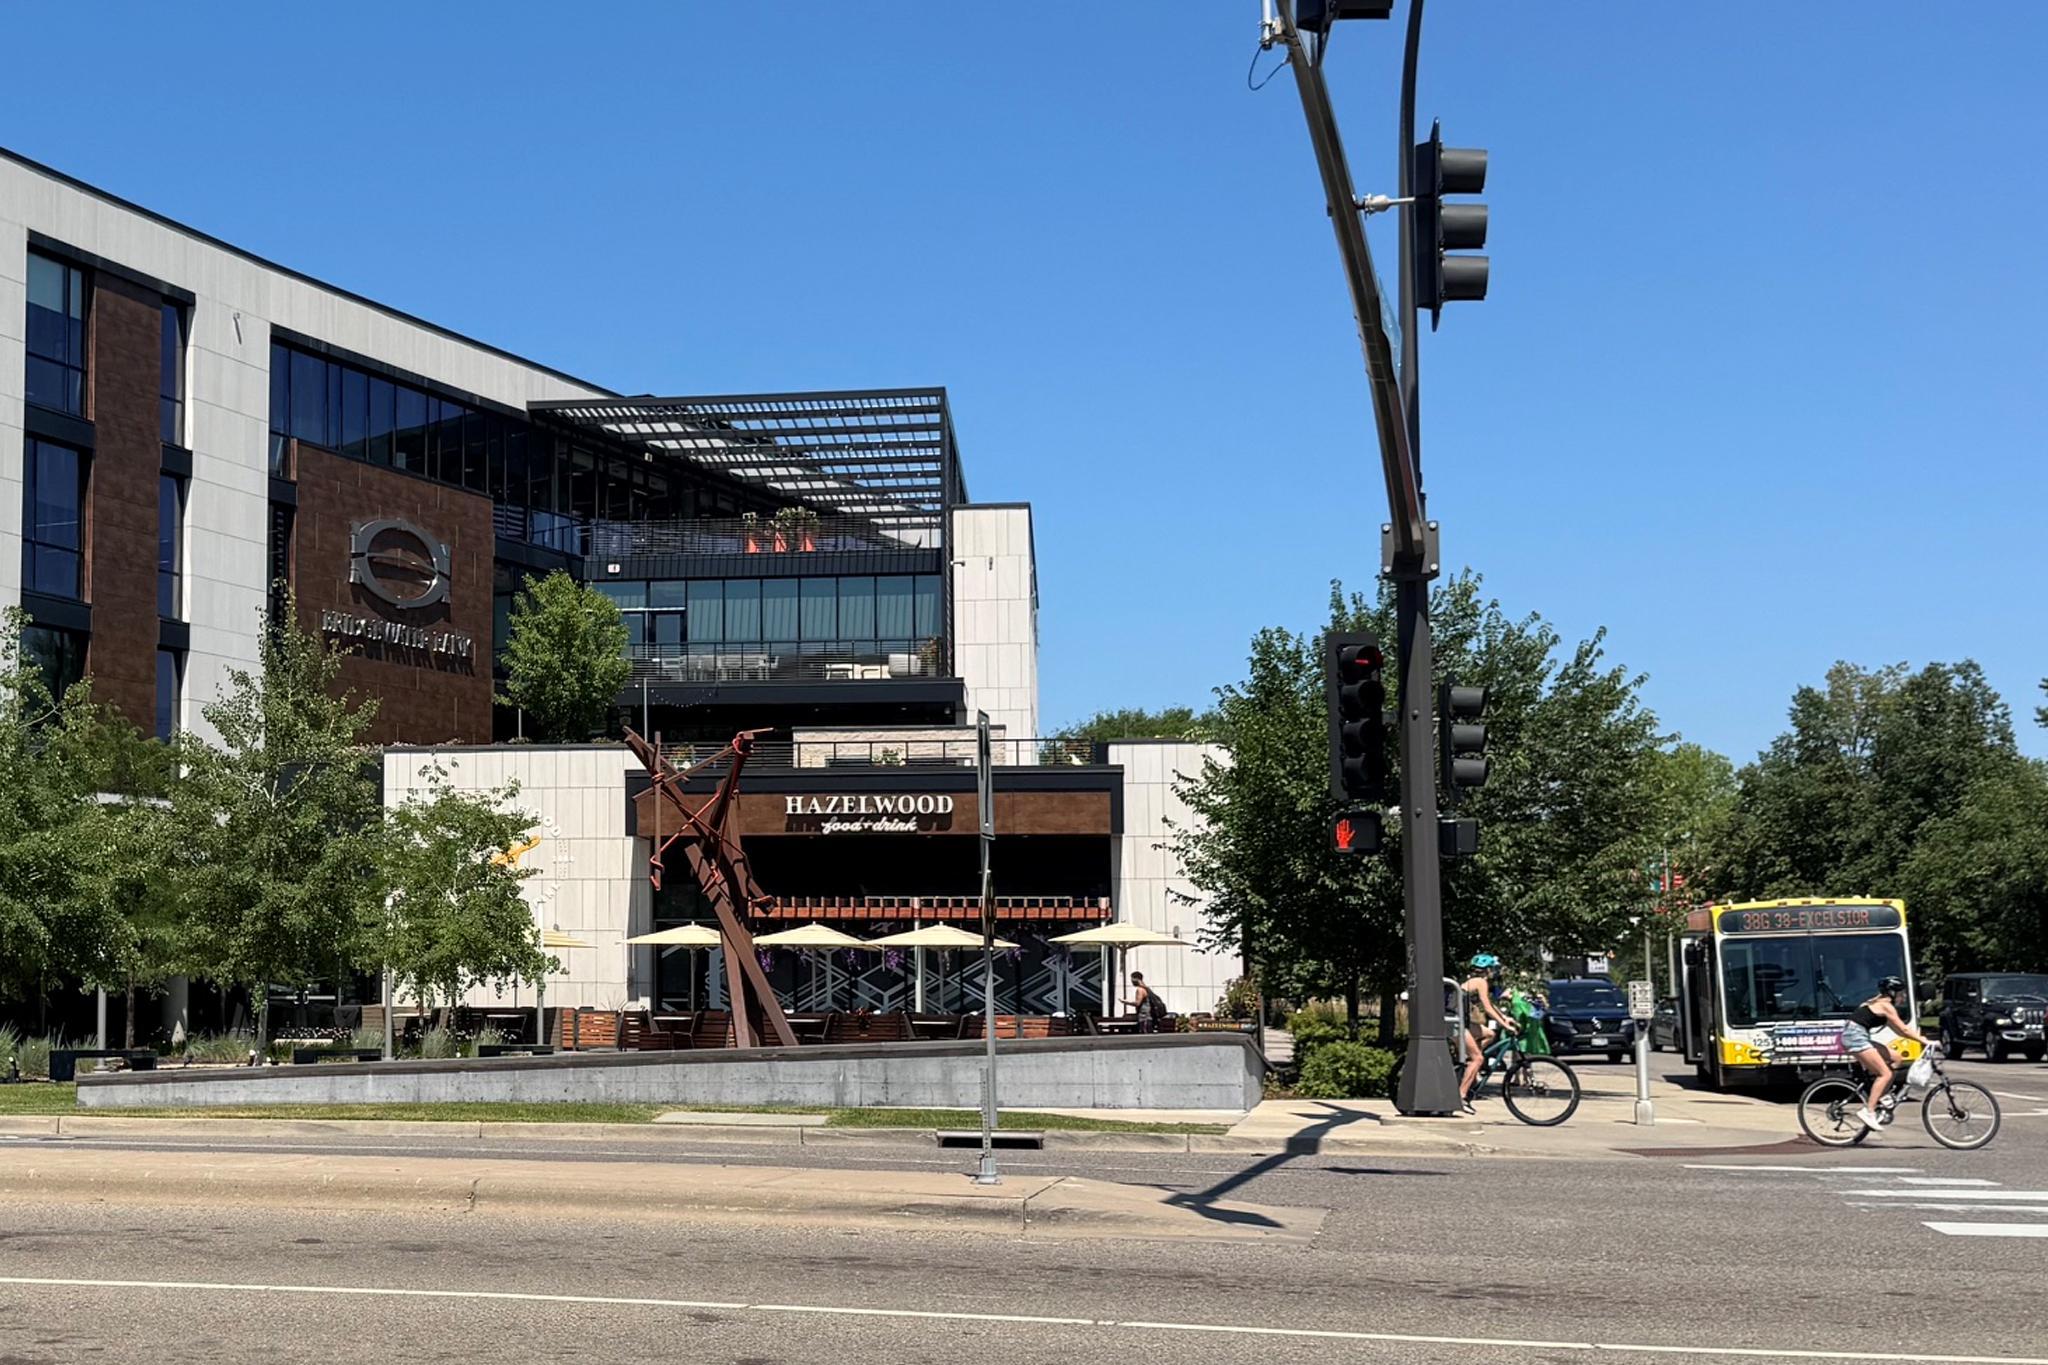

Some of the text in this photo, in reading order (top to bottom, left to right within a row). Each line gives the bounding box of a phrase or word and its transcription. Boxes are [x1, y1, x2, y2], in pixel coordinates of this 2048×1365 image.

[785, 795, 954, 814] HAZELWOOD
[1742, 910, 1869, 930] 38G 38-EXCELSIOR
